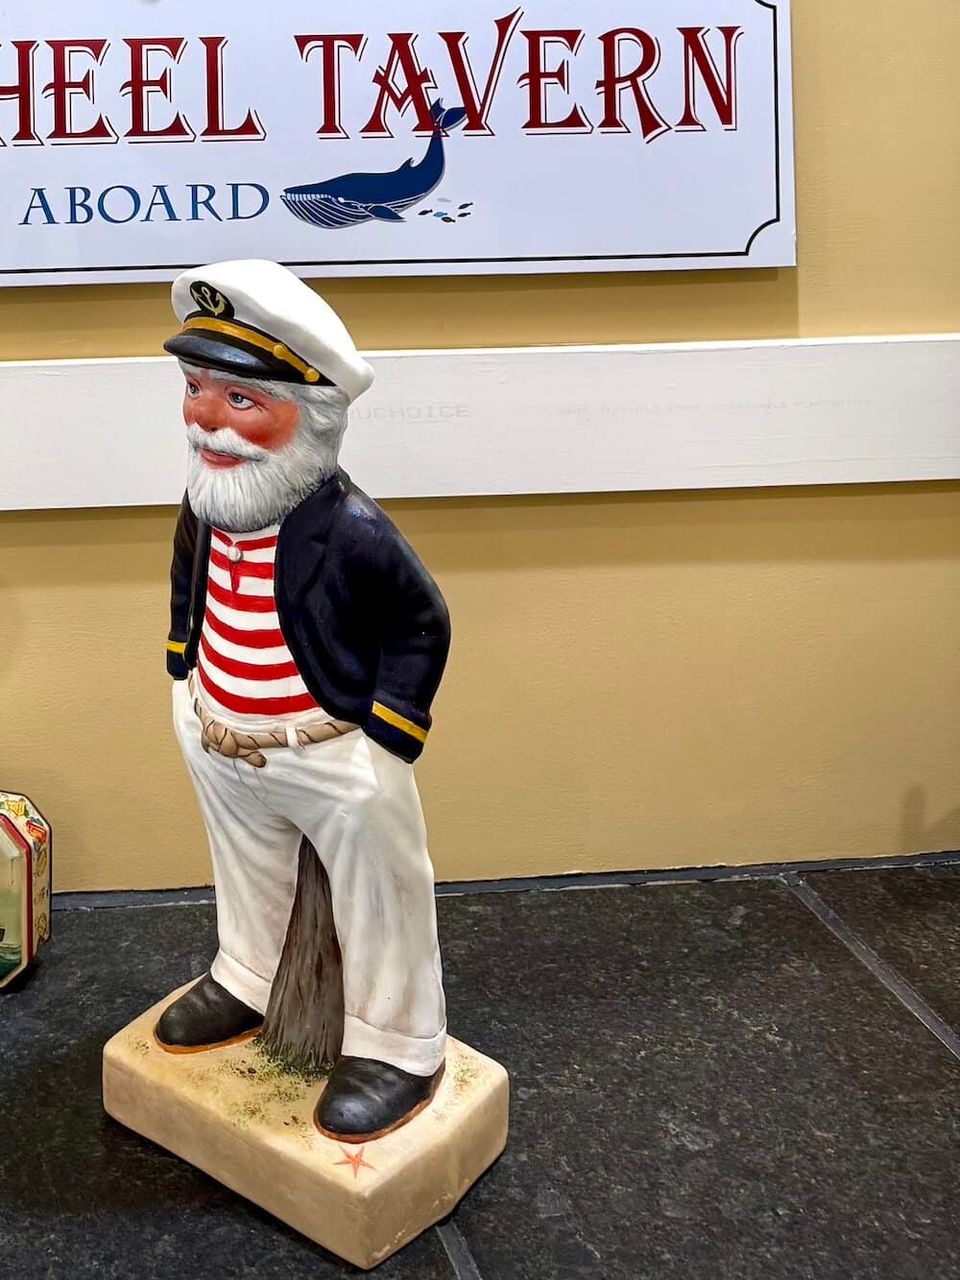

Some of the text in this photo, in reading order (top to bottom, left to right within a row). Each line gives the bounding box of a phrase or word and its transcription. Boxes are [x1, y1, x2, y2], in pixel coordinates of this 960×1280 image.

[294, 6, 744, 144] TAVERN
[19, 182, 270, 227] ABOARD
[352, 404, 473, 421] UCHOICE
